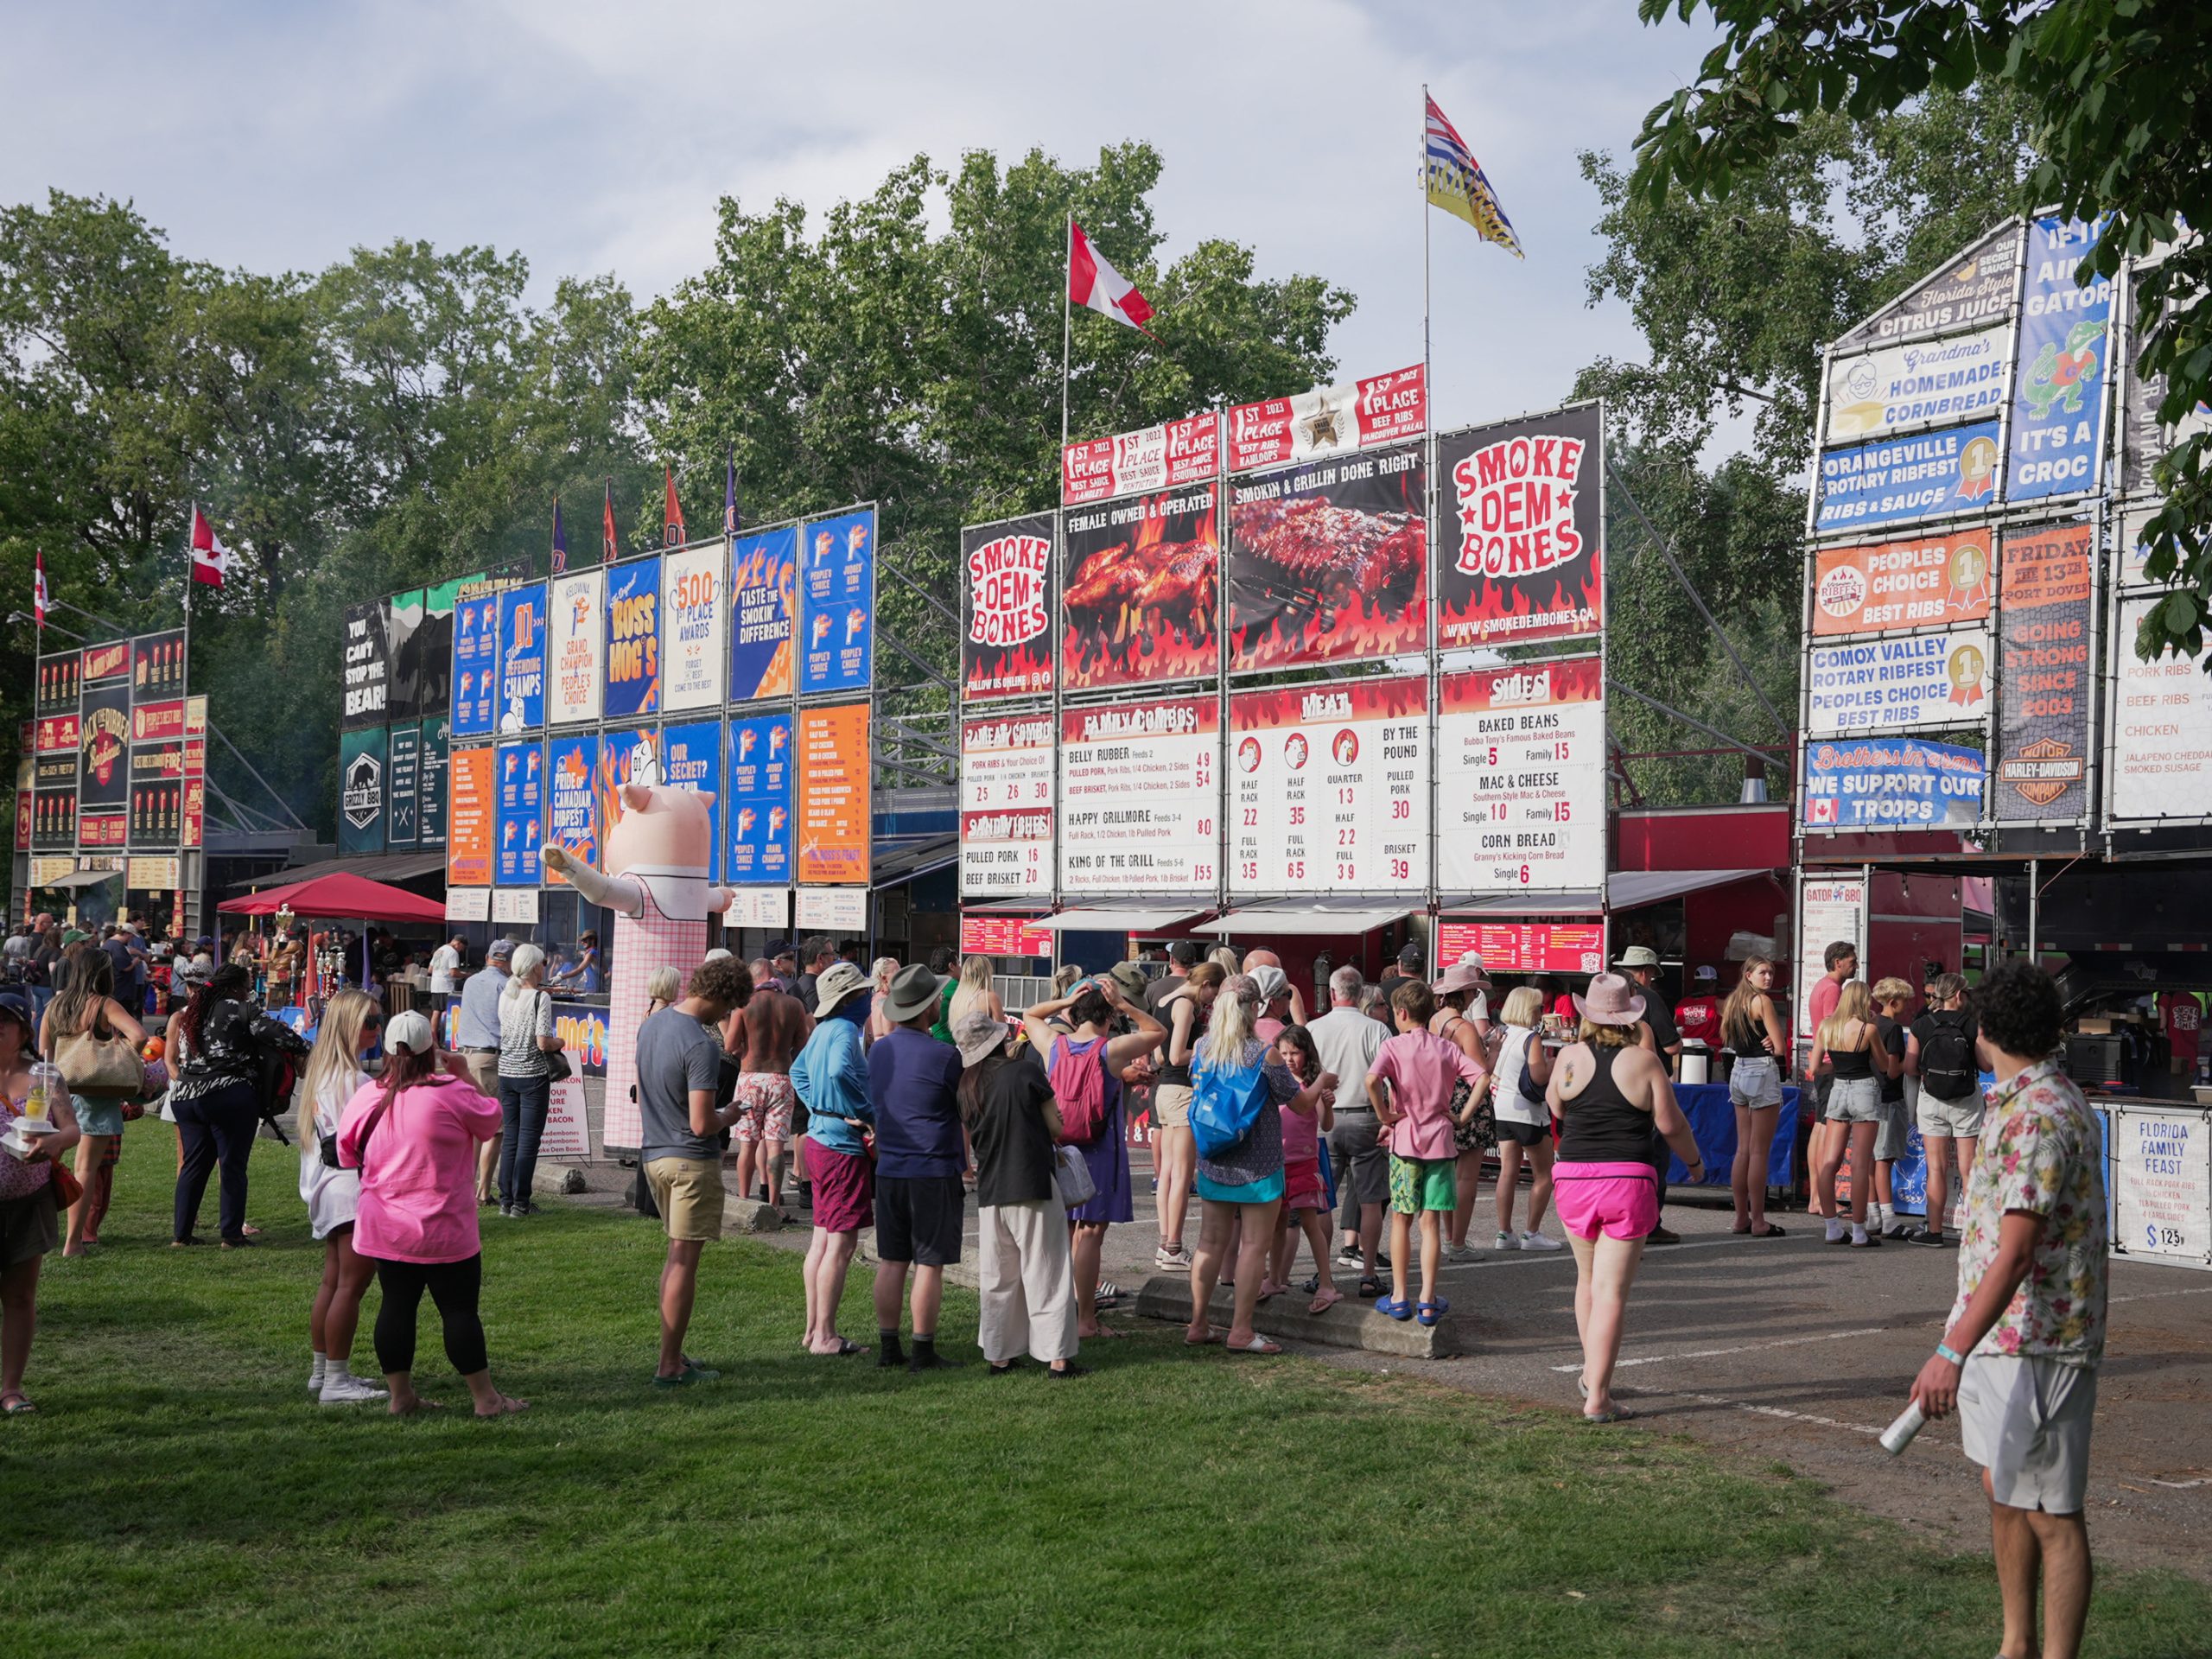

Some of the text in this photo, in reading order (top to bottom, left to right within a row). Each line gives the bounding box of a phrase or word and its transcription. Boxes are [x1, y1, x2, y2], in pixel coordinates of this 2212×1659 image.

[1996, 239, 2016, 252] OUR
[2048, 226, 2072, 250] IF
[1921, 274, 2013, 308] Florida Style
[1904, 338, 1991, 374] Grandma's
[1890, 360, 2000, 398] HOMEMADE
[1373, 388, 1420, 414] PLACE
[1885, 388, 2002, 424] CORNBREAD
[1362, 420, 1424, 442] VANCOUVER HALAL
[1177, 434, 1215, 456] PLACE
[1239, 449, 1278, 467] KAMLOOPS
[1825, 436, 1956, 476] ORANGEVILLE
[1173, 465, 1212, 482] ESQUIMALT
[1236, 452, 1418, 505] SMOKIN & GRILLIN DONE RIGHT
[1454, 439, 1582, 499] SMOKE
[1827, 458, 1959, 496] ROTARY RIBFEST
[2018, 454, 2088, 485] CROC
[1075, 488, 1104, 501] LANGLEY
[1068, 493, 1213, 534] FEMALE OWNED & OPERATED
[1459, 518, 1580, 573] BONES
[2006, 538, 2089, 563] FRIDAY
[1868, 547, 1946, 573] PEOPLES
[810, 569, 832, 582] PEOPLE'S
[566, 583, 590, 599] KELOWNA
[677, 571, 713, 610] 500
[812, 580, 830, 592] CHOICE
[2005, 582, 2088, 601] PORT DOVER
[741, 588, 778, 608] TASTE THE
[612, 592, 655, 641] BOSS
[687, 601, 714, 623] PLACE
[741, 605, 775, 626] SMOKIN'
[348, 619, 366, 639] YOU
[740, 620, 790, 644] DIFFERENCE
[1446, 607, 1595, 638] WWW.SMOKEDEMBONES.CA
[2013, 621, 2082, 643] GOING
[679, 622, 709, 643] AWARDS
[567, 639, 588, 656] GRAND
[1815, 638, 1948, 669] COMOX VALLEY
[2005, 645, 2088, 668] STRONG
[505, 657, 541, 677] DEFENDING
[561, 653, 593, 671] CHAMPION
[609, 634, 658, 683] HOG'S
[346, 661, 385, 685] STOP THE
[1814, 659, 1946, 688] ROTARY RIBFEST
[2127, 664, 2191, 678] PORK RIBS
[504, 673, 541, 699] CHAMPS
[562, 674, 591, 691] PEOPLE'S
[967, 675, 1026, 691] FOLLOW US ONLINE
[2018, 671, 2076, 691] SINCE
[346, 684, 386, 715] BEAR!
[564, 689, 588, 705] CHOICE
[2126, 694, 2190, 707] BEEF RIBS
[1837, 706, 1919, 727] BEST RIBS
[2021, 698, 2073, 717] 2003
[1479, 714, 1559, 733] BAKED BEANS
[2125, 724, 2179, 737] CHICKEN
[1465, 730, 1575, 746] Bubba Tony's Famous Baked Beans
[671, 743, 688, 762] OUR
[1384, 745, 1417, 759] POUND
[1526, 742, 1569, 761] Family 15
[671, 760, 708, 780] SECRET?
[2005, 760, 2079, 778] HARLEY-DAVIDSON
[2124, 763, 2201, 774] SMOKED SUSAGE
[554, 772, 575, 791] PRIDE
[1196, 771, 1210, 787] 54
[1479, 772, 1560, 790] MAC & CHEESE
[1809, 773, 1981, 796] WE SUPPORT OUR
[346, 791, 379, 807] GRIZZLY BBQ
[554, 790, 591, 809] CANADIAN
[1035, 783, 1047, 798] 30
[1390, 785, 1410, 795] PORK
[554, 809, 583, 827] RIBFEST
[1069, 812, 1098, 825] HAPPY
[1103, 810, 1151, 823] GRILLMORE
[1243, 809, 1257, 826] 22
[1335, 814, 1355, 823] HALF
[1853, 800, 1933, 819] TROOPS
[966, 850, 1019, 863] PULLED PORK
[1069, 856, 1090, 868] KING
[1096, 855, 1105, 868] OF
[1110, 855, 1125, 867] THE
[1128, 855, 1154, 867] GRILL
[1240, 849, 1258, 859] RACK
[1287, 848, 1306, 857] RACK
[1474, 850, 1565, 862] Granny's Kicking Corn Bread
[1391, 859, 1408, 879] 39
[1494, 865, 1529, 883] Single 6
[1807, 888, 1861, 902] GATOR BBQ
[2140, 1122, 2189, 1139] FLORIDA
[2142, 1141, 2185, 1157] FAMILY
[2145, 1158, 2182, 1175] FEAST
